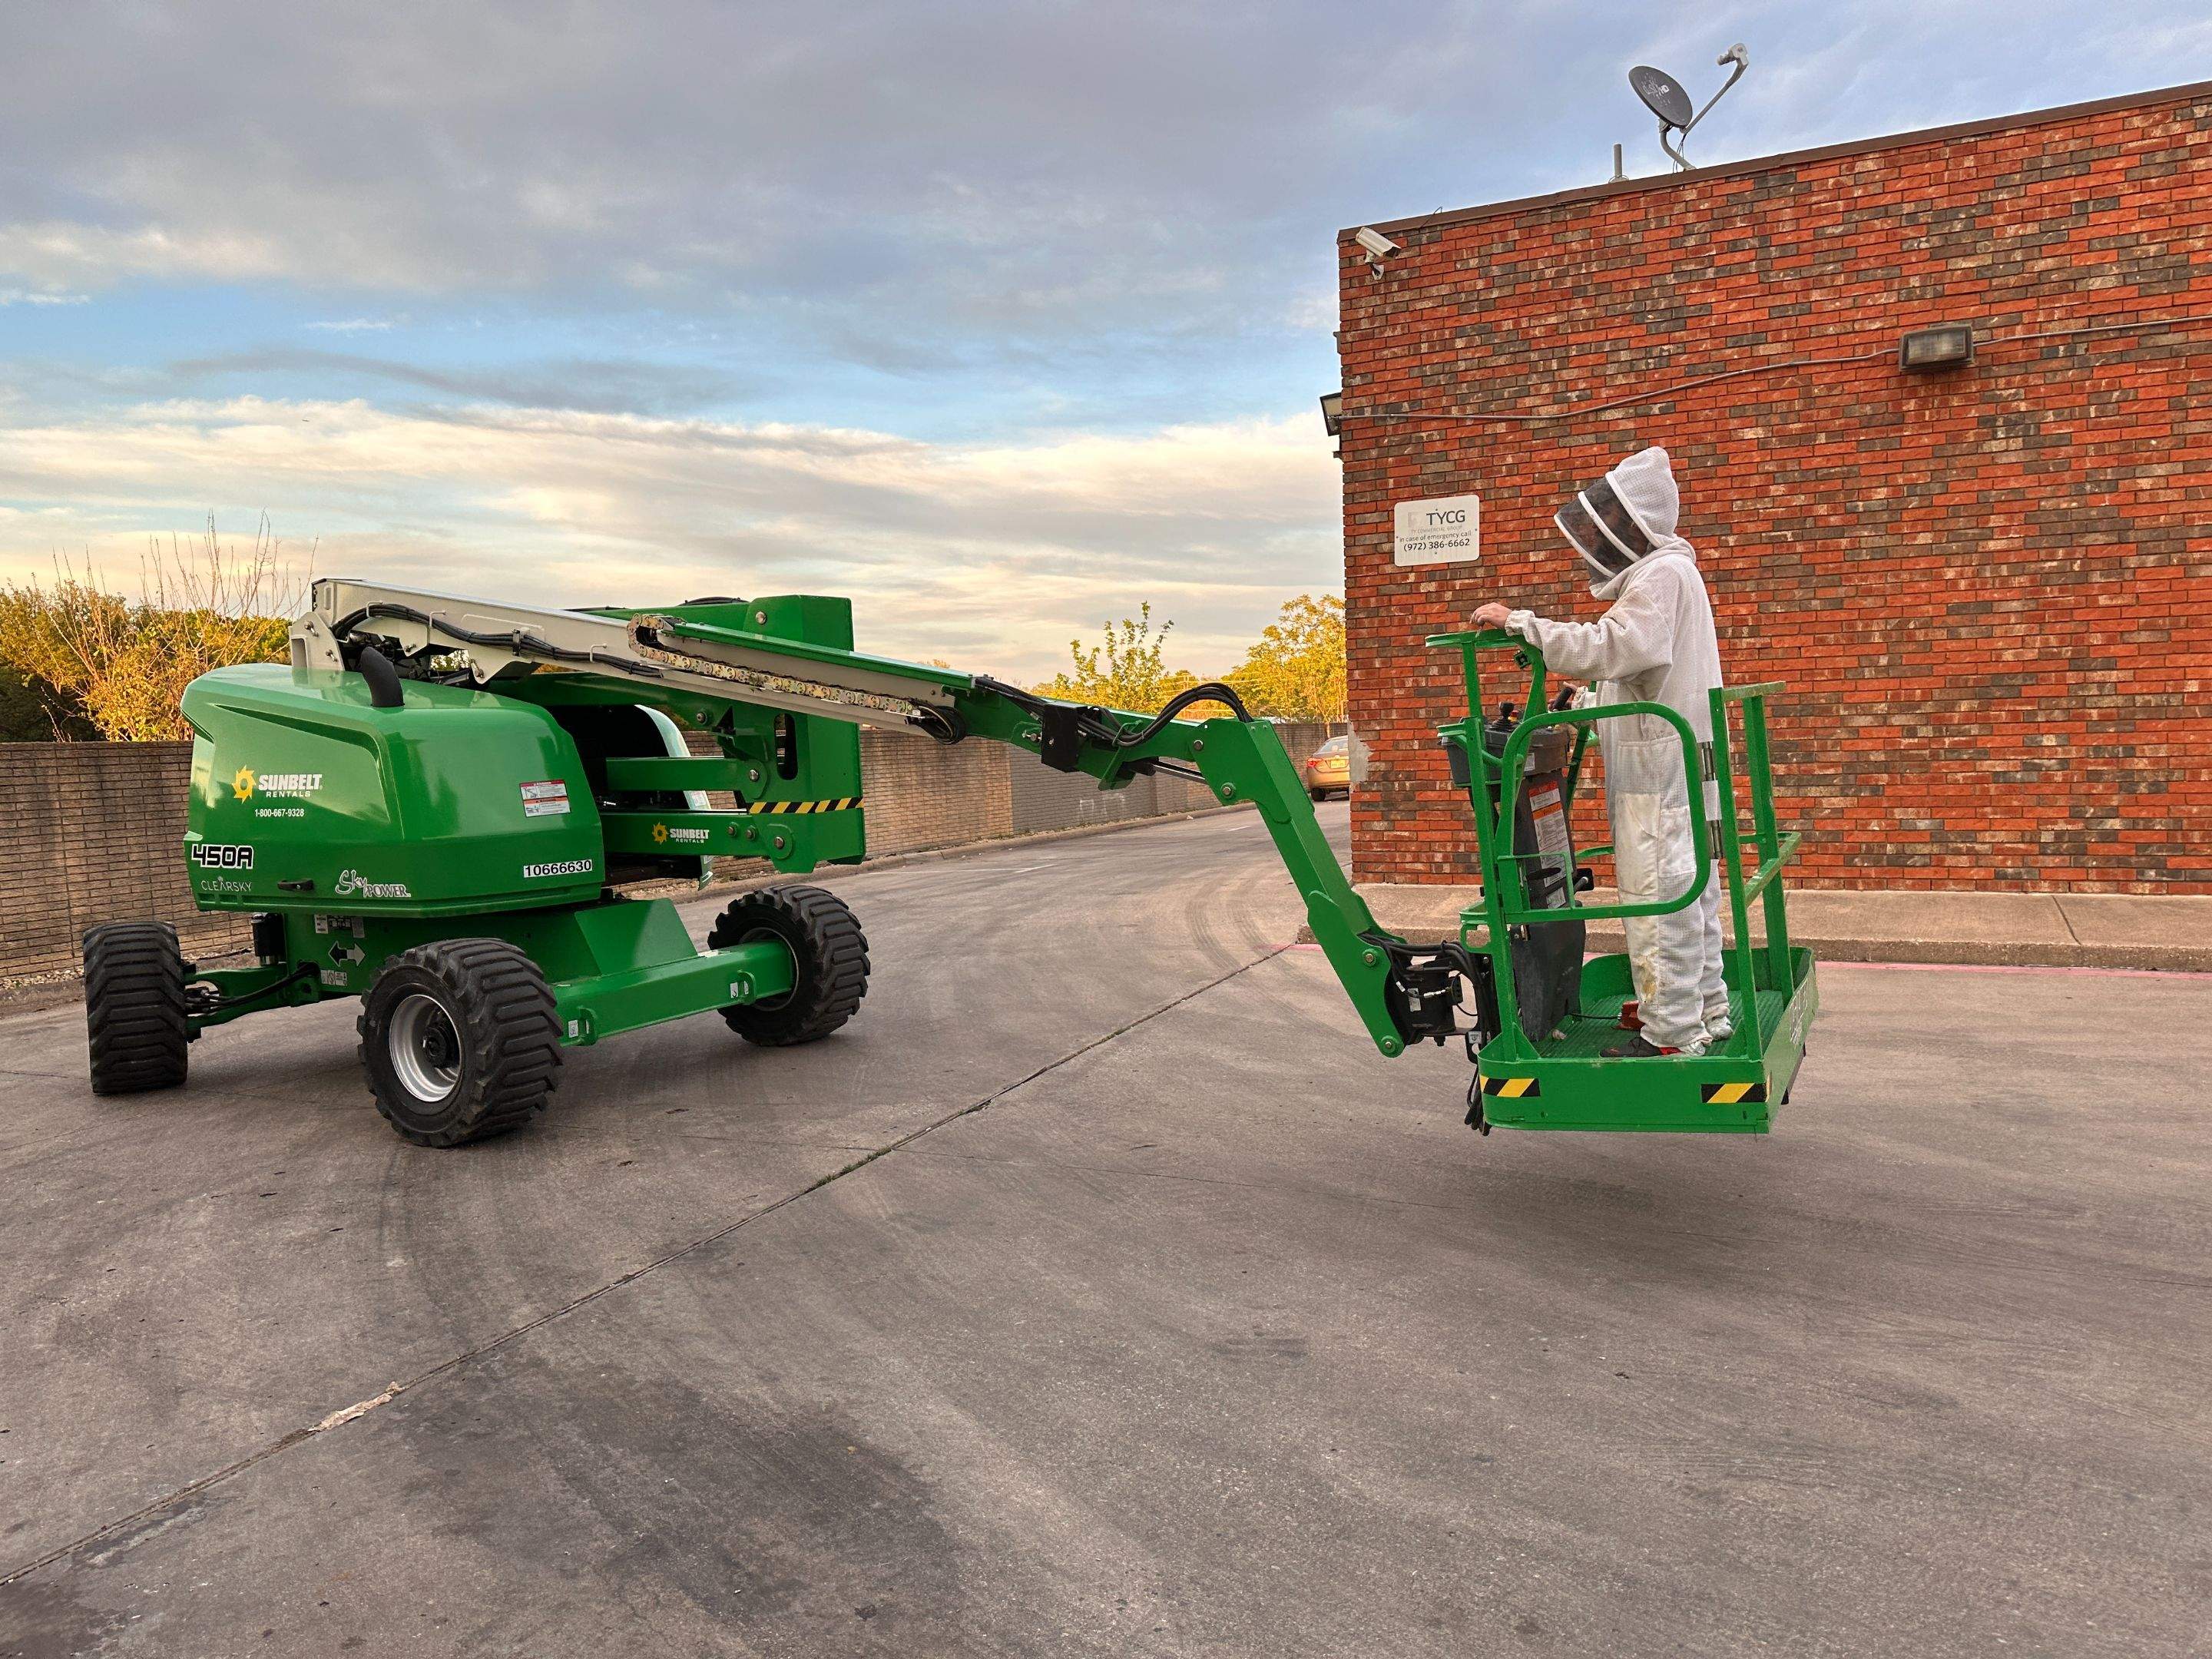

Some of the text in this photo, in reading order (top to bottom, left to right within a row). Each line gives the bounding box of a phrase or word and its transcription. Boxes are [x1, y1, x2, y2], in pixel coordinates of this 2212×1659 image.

[1426, 510, 1465, 525] TYCG
[1404, 538, 1470, 551] (972) 386-6662
[258, 774, 323, 790] SUNBELT
[254, 809, 304, 817] 1-800-667-9328
[670, 828, 710, 839] SUNBELT
[191, 844, 253, 869] 450A
[525, 860, 591, 876] 10666630
[200, 879, 252, 891] CLEARSKY
